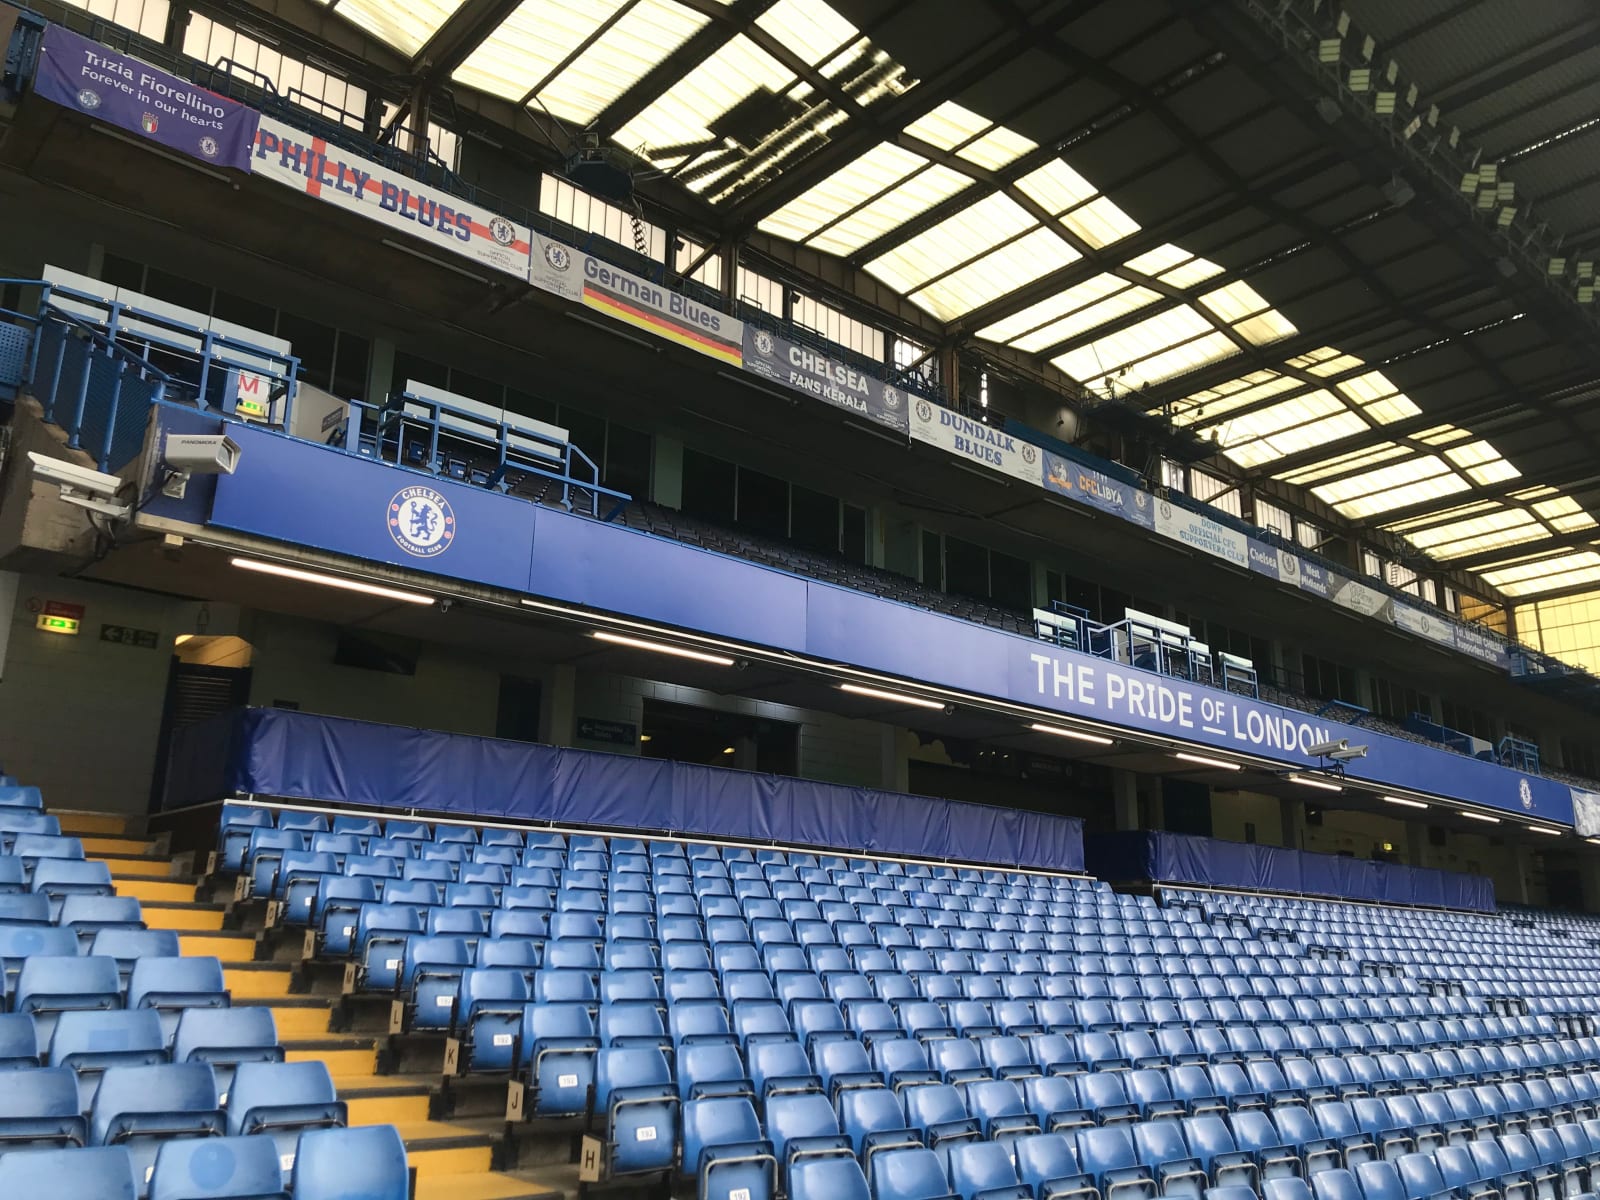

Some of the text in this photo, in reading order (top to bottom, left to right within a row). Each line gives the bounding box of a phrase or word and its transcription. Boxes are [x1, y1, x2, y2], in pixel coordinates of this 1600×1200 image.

[81, 66, 223, 130] Forever in our hearts
[84, 50, 225, 119] Trizia Fiorellino
[255, 128, 472, 242] PHILLY BLUES
[583, 255, 721, 332] German Blues
[237, 371, 260, 395] M
[789, 346, 869, 396] CHELSEA
[789, 371, 868, 413] FANS KERALA
[940, 410, 1016, 453] DUNDALK
[954, 435, 1003, 467] BLUES
[402, 488, 446, 509] CHELSEA
[1188, 524, 1221, 544] OFFICIAL
[1222, 537, 1237, 550] CFC
[1201, 518, 1223, 533] DOWN
[396, 535, 442, 554] FOOTBALL CLUB
[1179, 530, 1245, 563] SUPPORTERS CLUB
[1249, 547, 1278, 569] Chelsea
[1031, 653, 1096, 705] THE
[1106, 673, 1194, 728] PRIDE
[1201, 698, 1226, 724] OF
[393, 1009, 399, 1025] L
[447, 1048, 455, 1065] K
[511, 1091, 518, 1110] J
[585, 1150, 595, 1170] H
